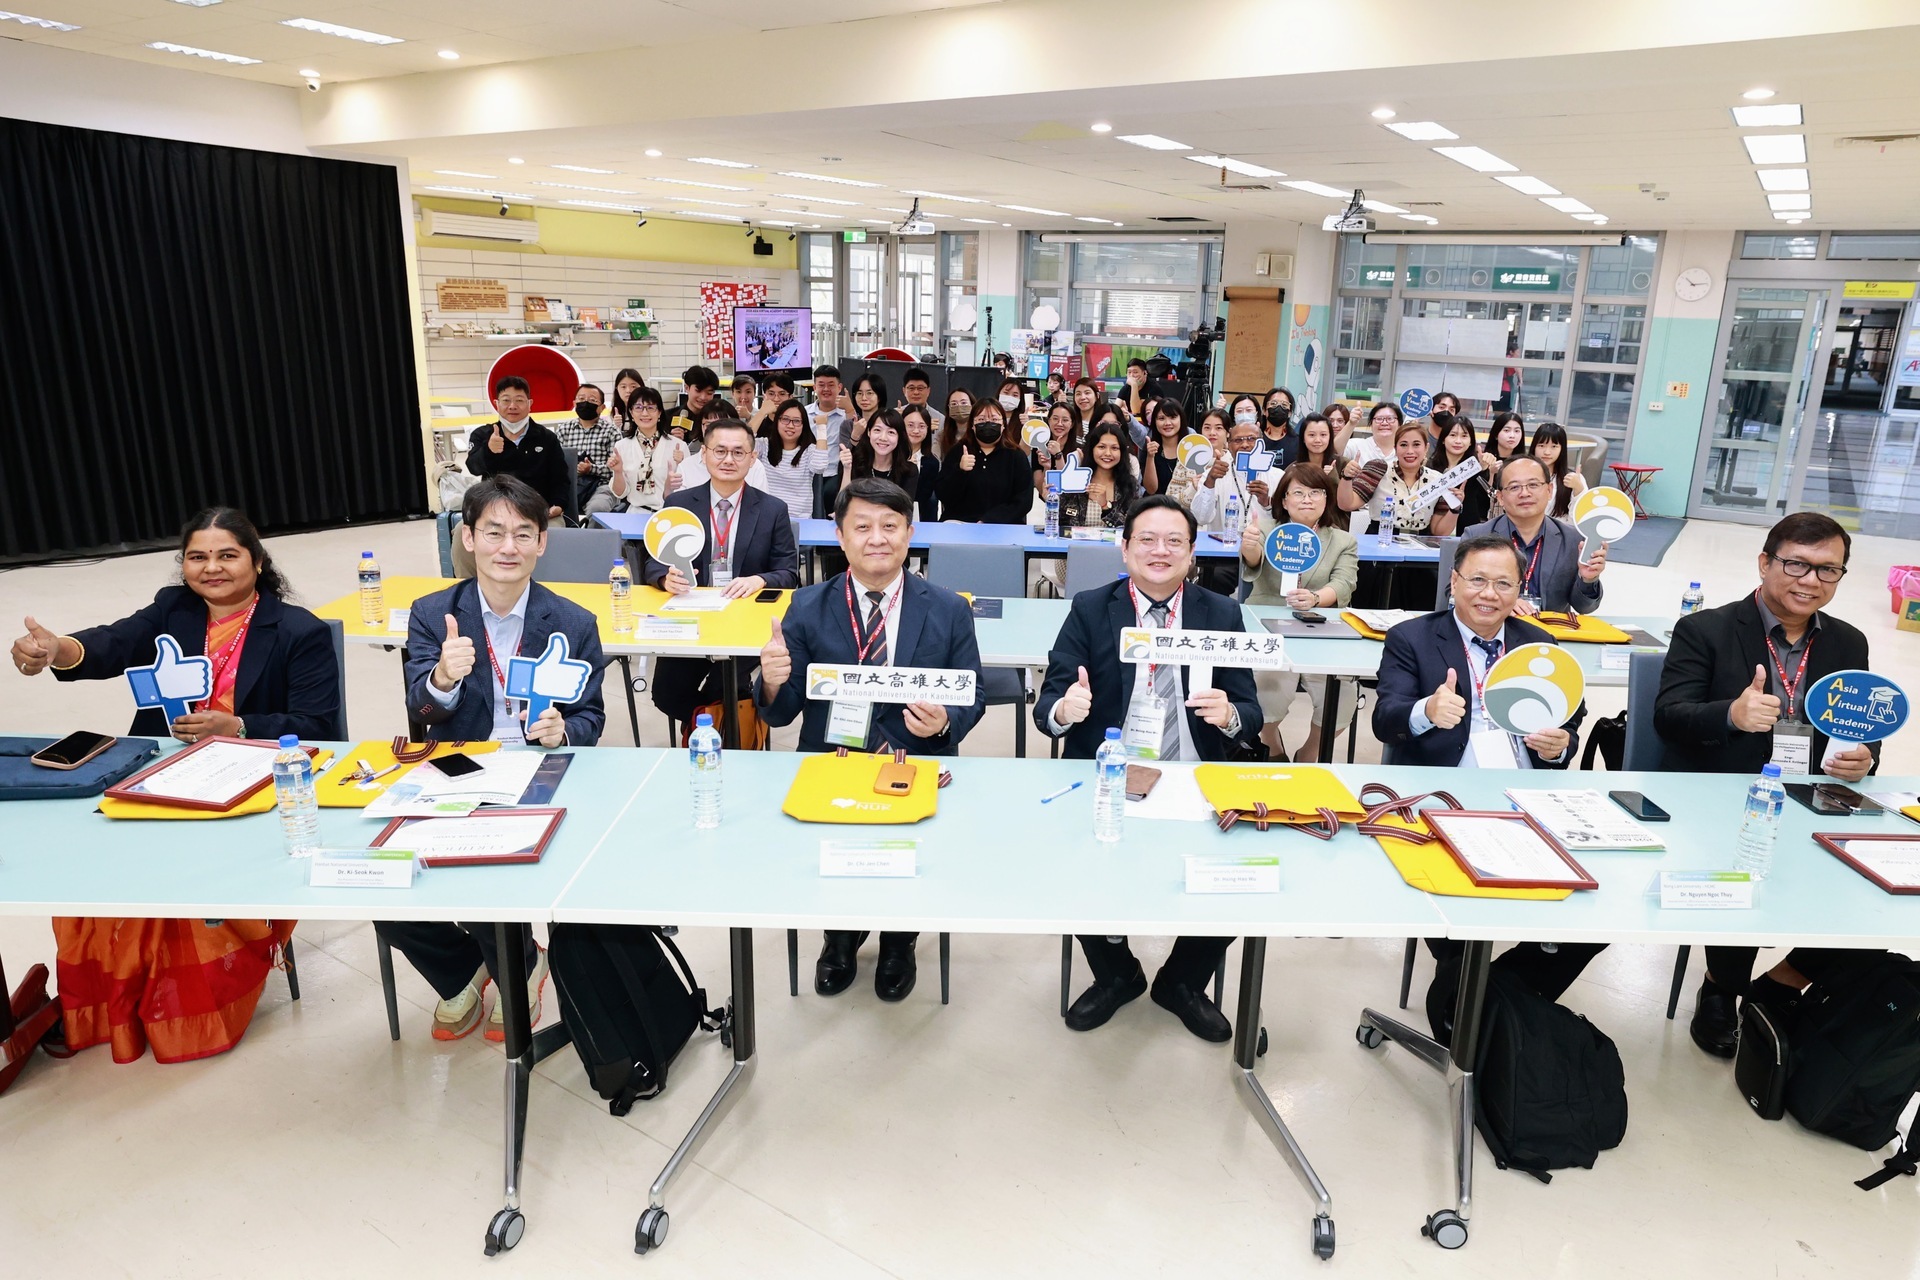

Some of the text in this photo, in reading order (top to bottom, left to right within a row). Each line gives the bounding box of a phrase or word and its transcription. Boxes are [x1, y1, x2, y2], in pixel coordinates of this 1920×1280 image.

[1277, 529, 1293, 540] Asia
[1276, 540, 1299, 552] Virtual
[1274, 552, 1305, 565] Academy
[1155, 635, 1280, 654] 國立高雄大學
[1189, 653, 1226, 662] University
[1241, 656, 1279, 665] Kaohsiung
[843, 672, 972, 690] 國立高雄大學
[1830, 678, 1858, 695] Asia
[878, 690, 916, 699] University
[930, 693, 970, 702] Kaohsiung
[1827, 692, 1867, 713] Virtual
[1820, 709, 1874, 731] Academy
[856, 801, 892, 811] NUK
